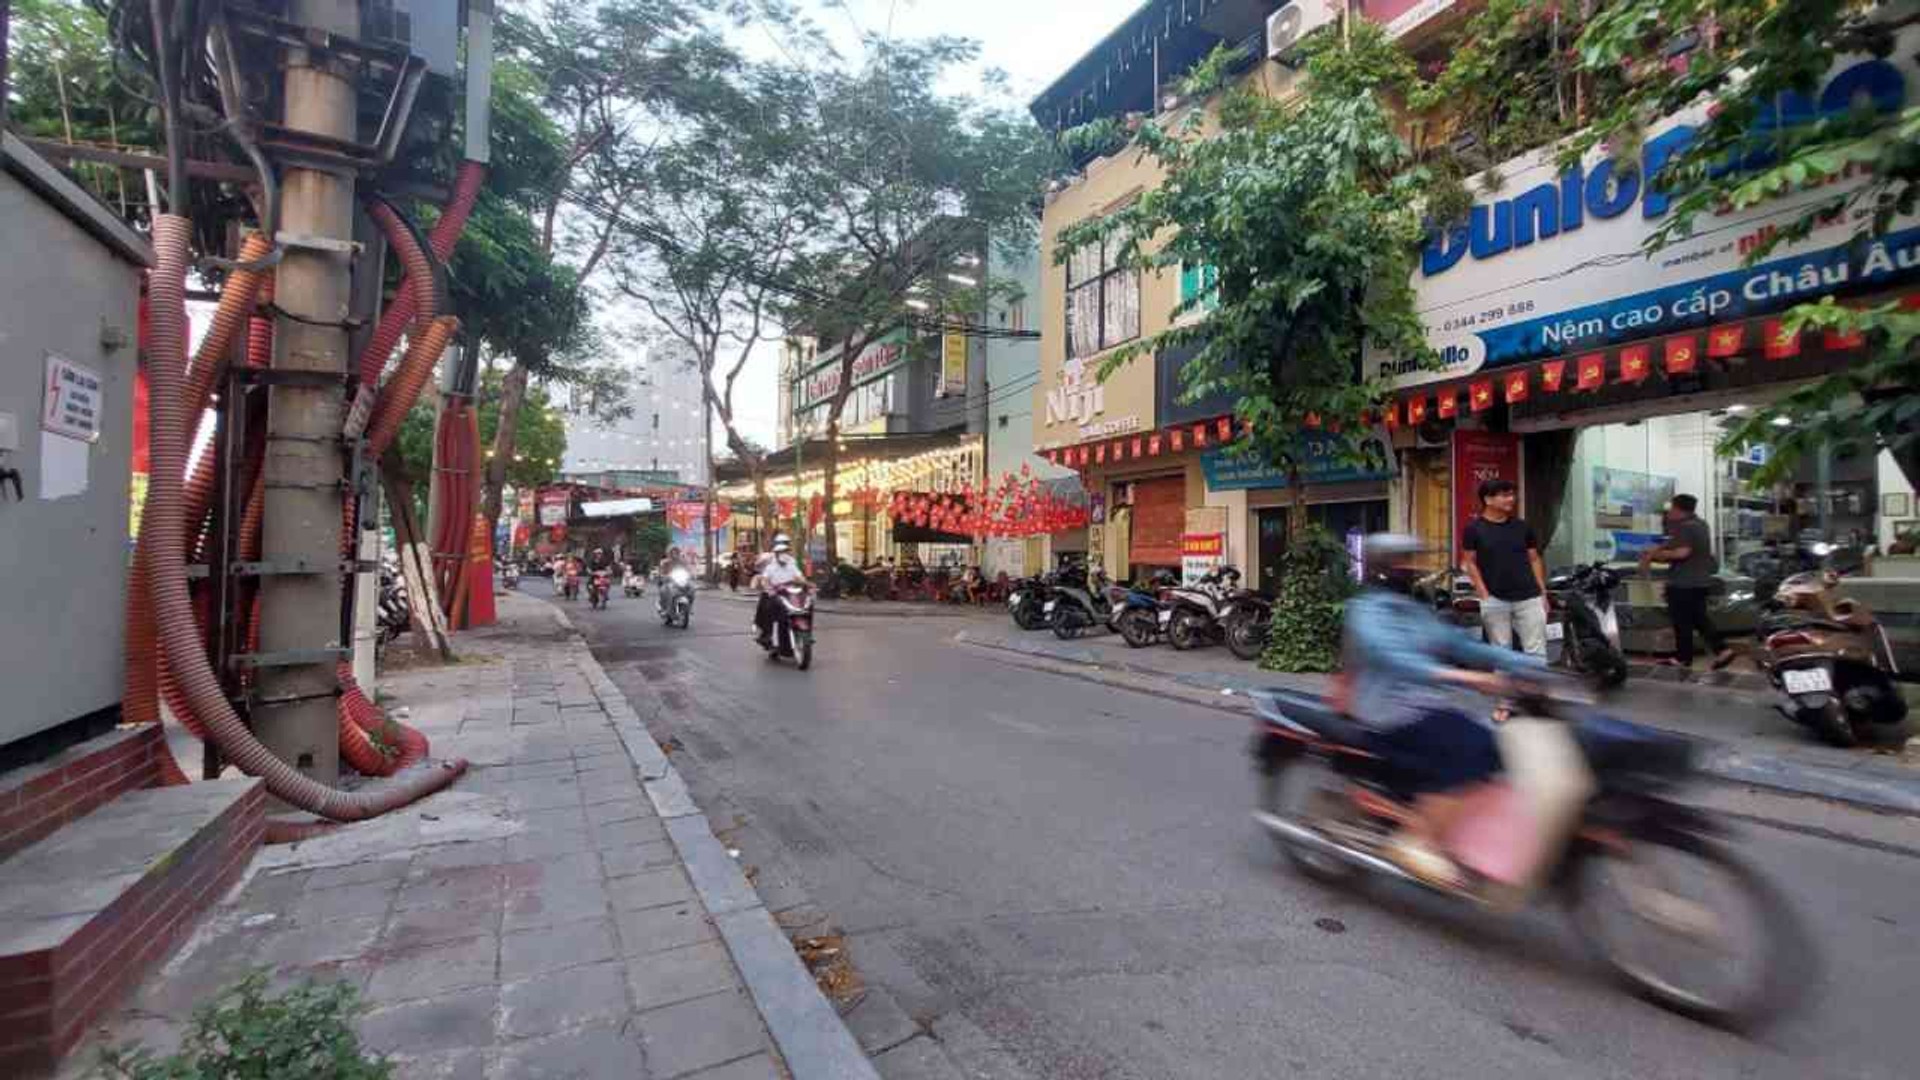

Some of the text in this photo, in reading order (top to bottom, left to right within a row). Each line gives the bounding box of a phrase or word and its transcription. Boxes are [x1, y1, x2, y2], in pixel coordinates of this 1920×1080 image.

[1542, 315, 1604, 348] Nệm
[1610, 304, 1664, 332] cao
[1672, 287, 1731, 324] cấp
[1743, 261, 1849, 301] Châu
